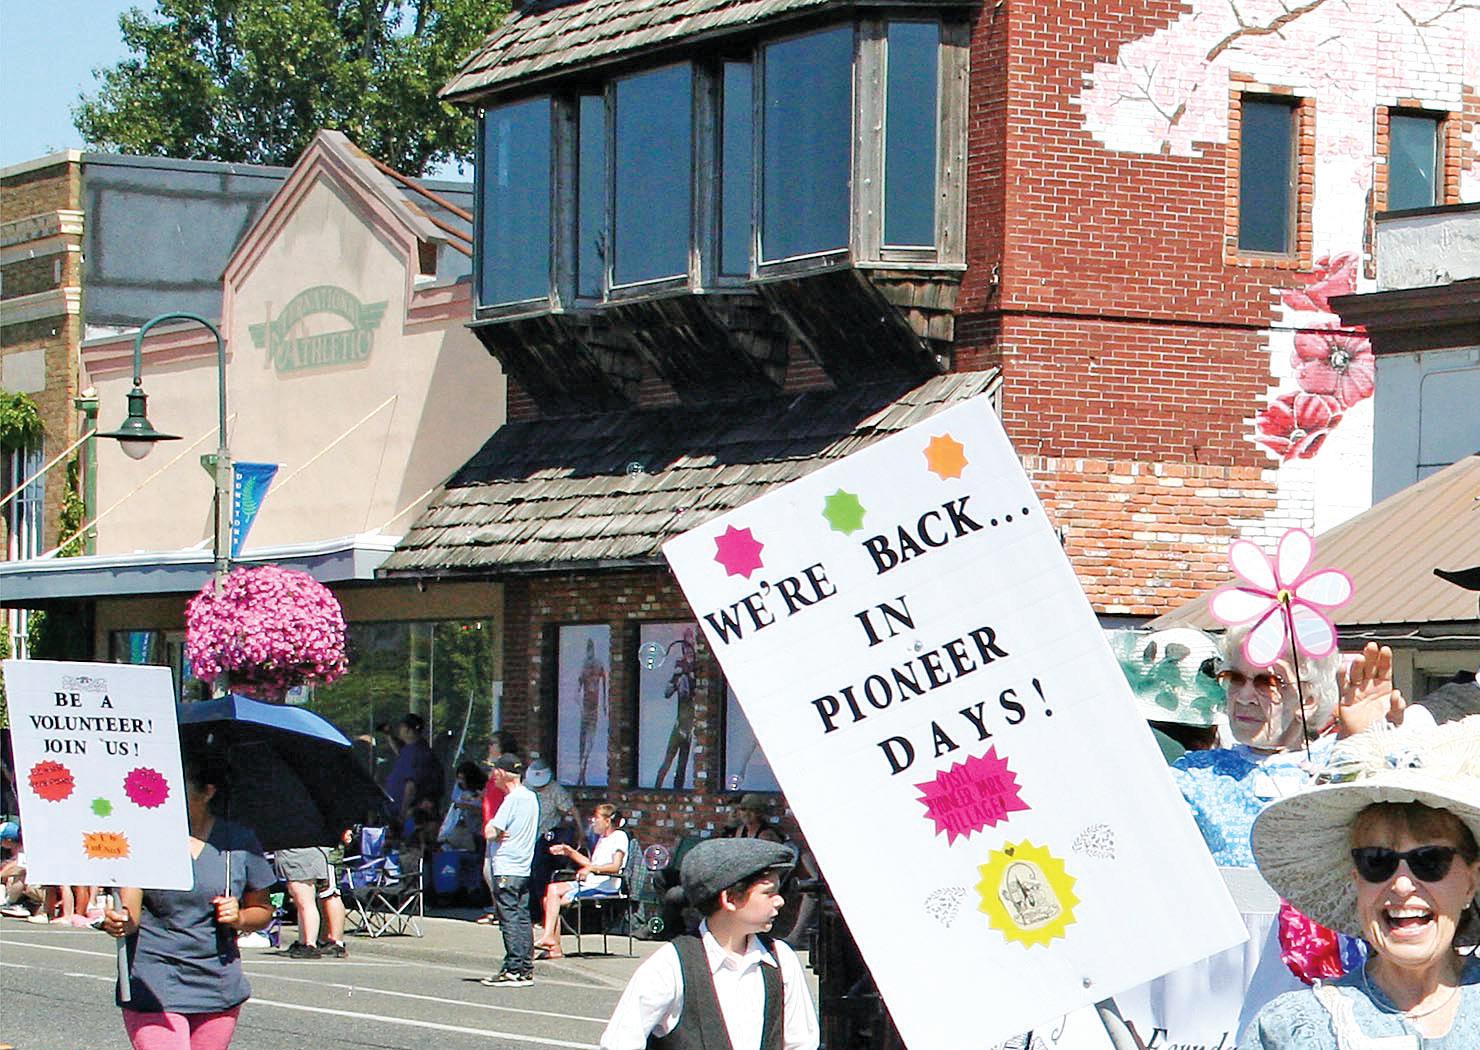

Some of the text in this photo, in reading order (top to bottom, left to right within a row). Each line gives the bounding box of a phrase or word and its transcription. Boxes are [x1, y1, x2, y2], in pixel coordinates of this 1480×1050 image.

[703, 562, 838, 646] WE'RE
[854, 595, 917, 648] IN
[54, 691, 114, 709] BE A
[811, 624, 1010, 735] PIONEER
[29, 714, 153, 734] VOLUNTEER!
[44, 738, 139, 757] JOIN US!
[877, 677, 1054, 777] DAYS!
